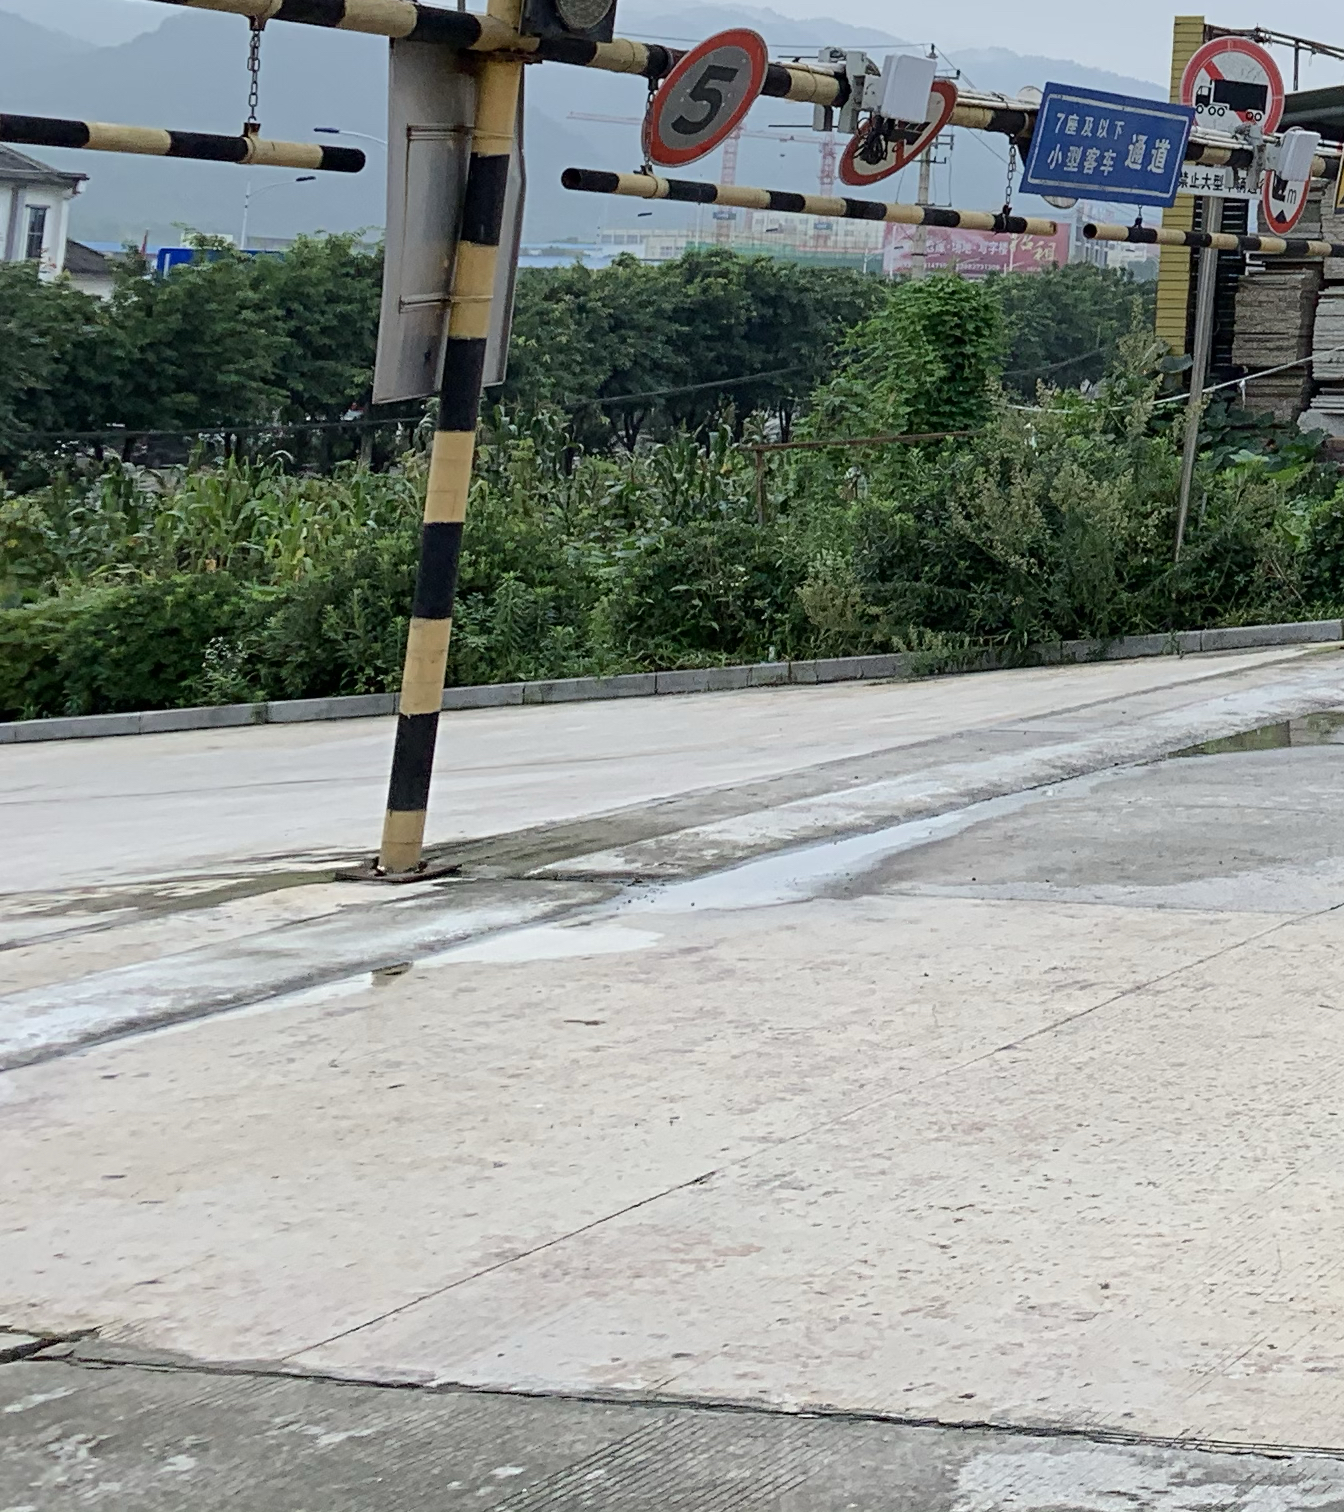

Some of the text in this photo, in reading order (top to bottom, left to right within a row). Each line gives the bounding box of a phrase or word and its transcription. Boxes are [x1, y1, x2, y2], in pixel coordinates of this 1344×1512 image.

[671, 63, 739, 136] 5
[1055, 112, 1126, 139] 7座及以下
[1047, 143, 1118, 176] 小型客车
[1124, 134, 1172, 174] 通道
